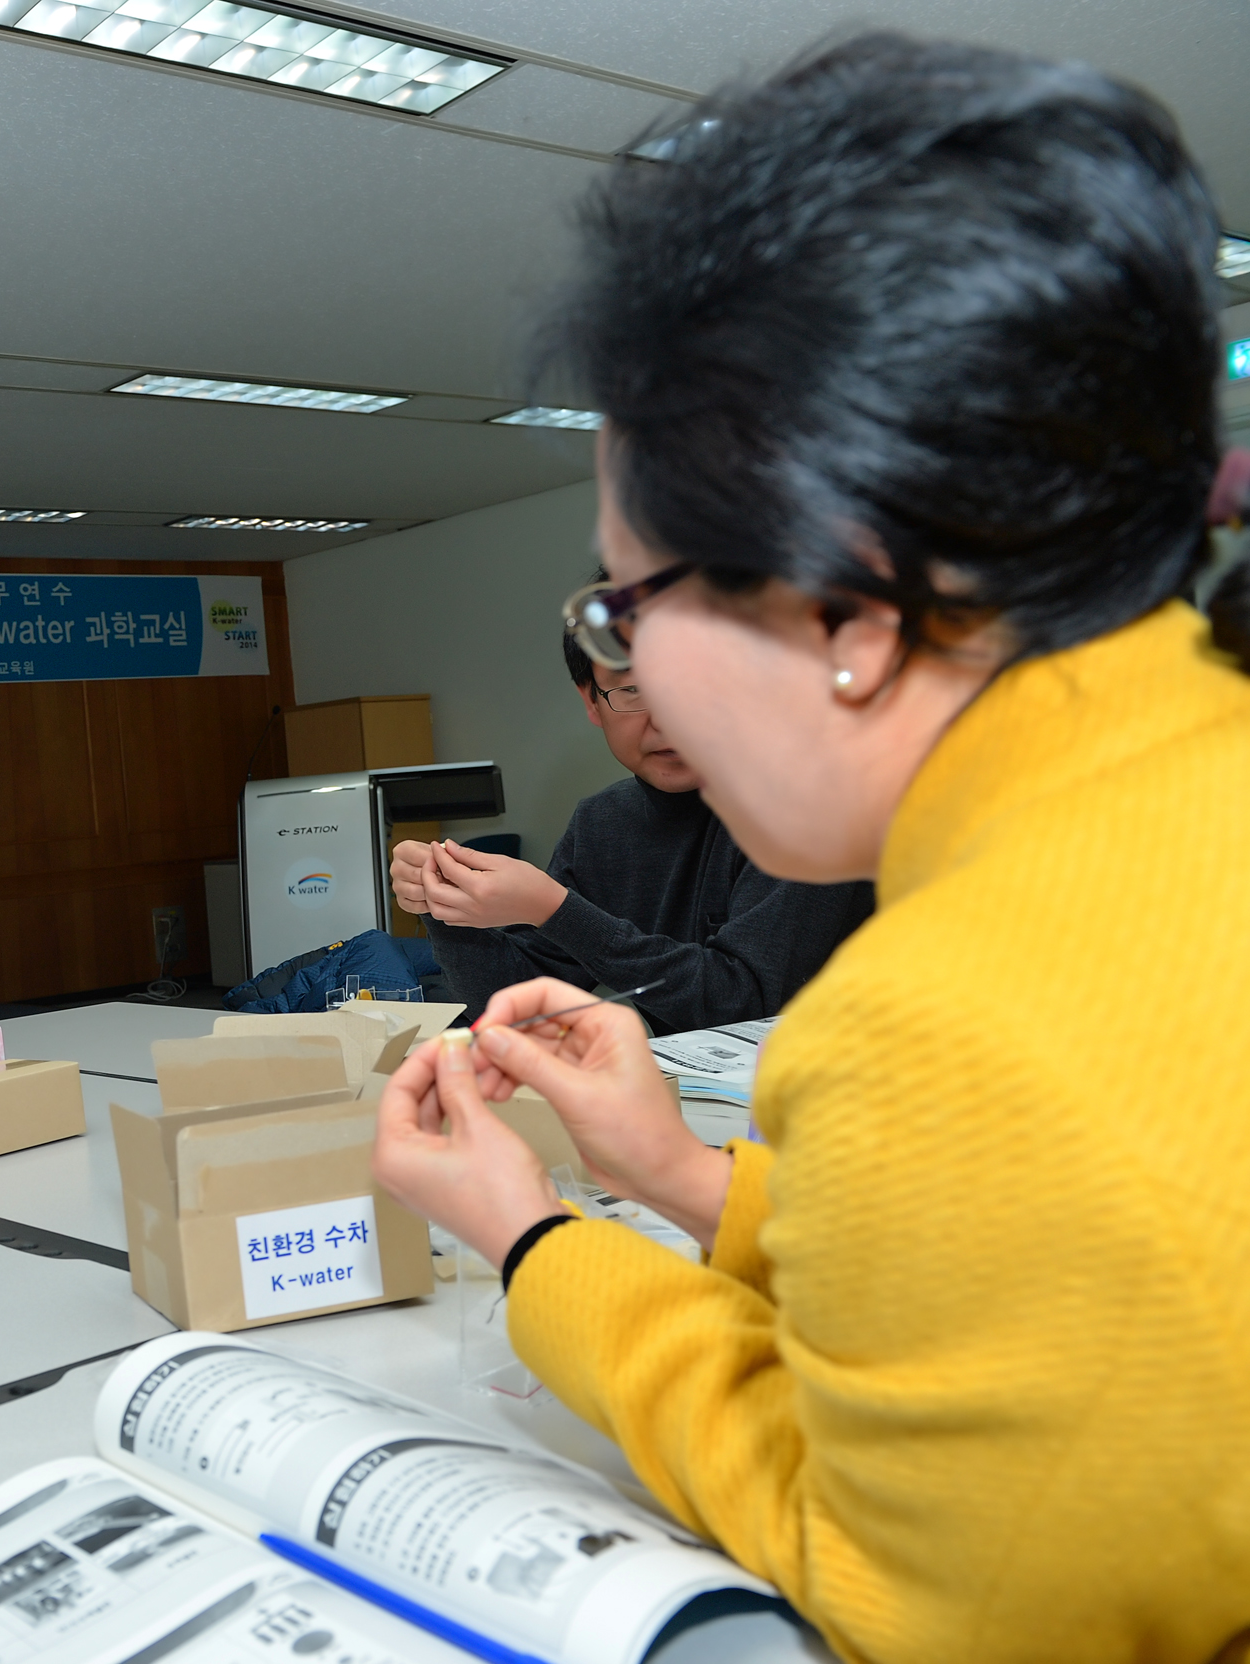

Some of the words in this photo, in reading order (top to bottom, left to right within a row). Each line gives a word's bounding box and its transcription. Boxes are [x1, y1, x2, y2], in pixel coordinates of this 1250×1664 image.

[211, 606, 249, 617] SMART
[212, 617, 243, 625] K-water
[85, 610, 188, 648] 과학교실
[224, 630, 258, 641] START
[239, 641, 258, 649] 2014
[293, 825, 339, 836] STATION
[288, 885, 295, 895] K
[298, 884, 329, 895] water
[247, 1229, 315, 1262] 친환경
[324, 1220, 369, 1249] 수차
[271, 1266, 354, 1292] K-water
